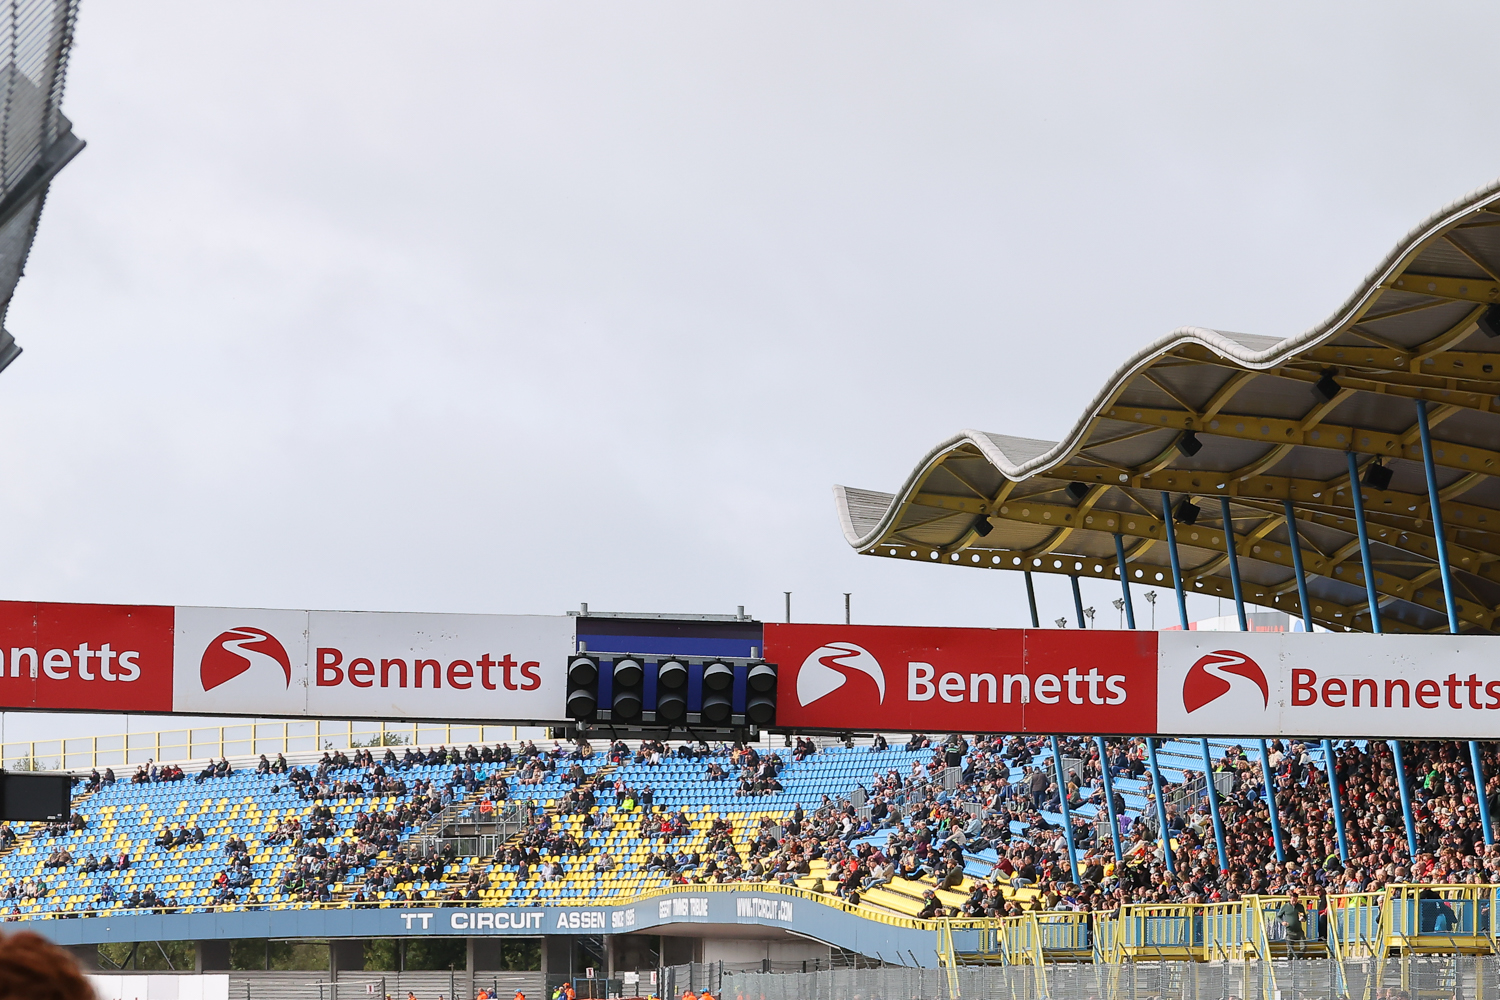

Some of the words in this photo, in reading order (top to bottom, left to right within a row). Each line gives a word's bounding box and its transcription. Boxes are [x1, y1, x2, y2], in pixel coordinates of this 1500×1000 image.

[0, 642, 141, 682] netts
[316, 647, 541, 691] Bennetts
[907, 661, 1127, 705] Bennetts
[401, 913, 434, 929] TT
[450, 912, 544, 929] CIRCUIT
[556, 911, 606, 929] ASSEN
